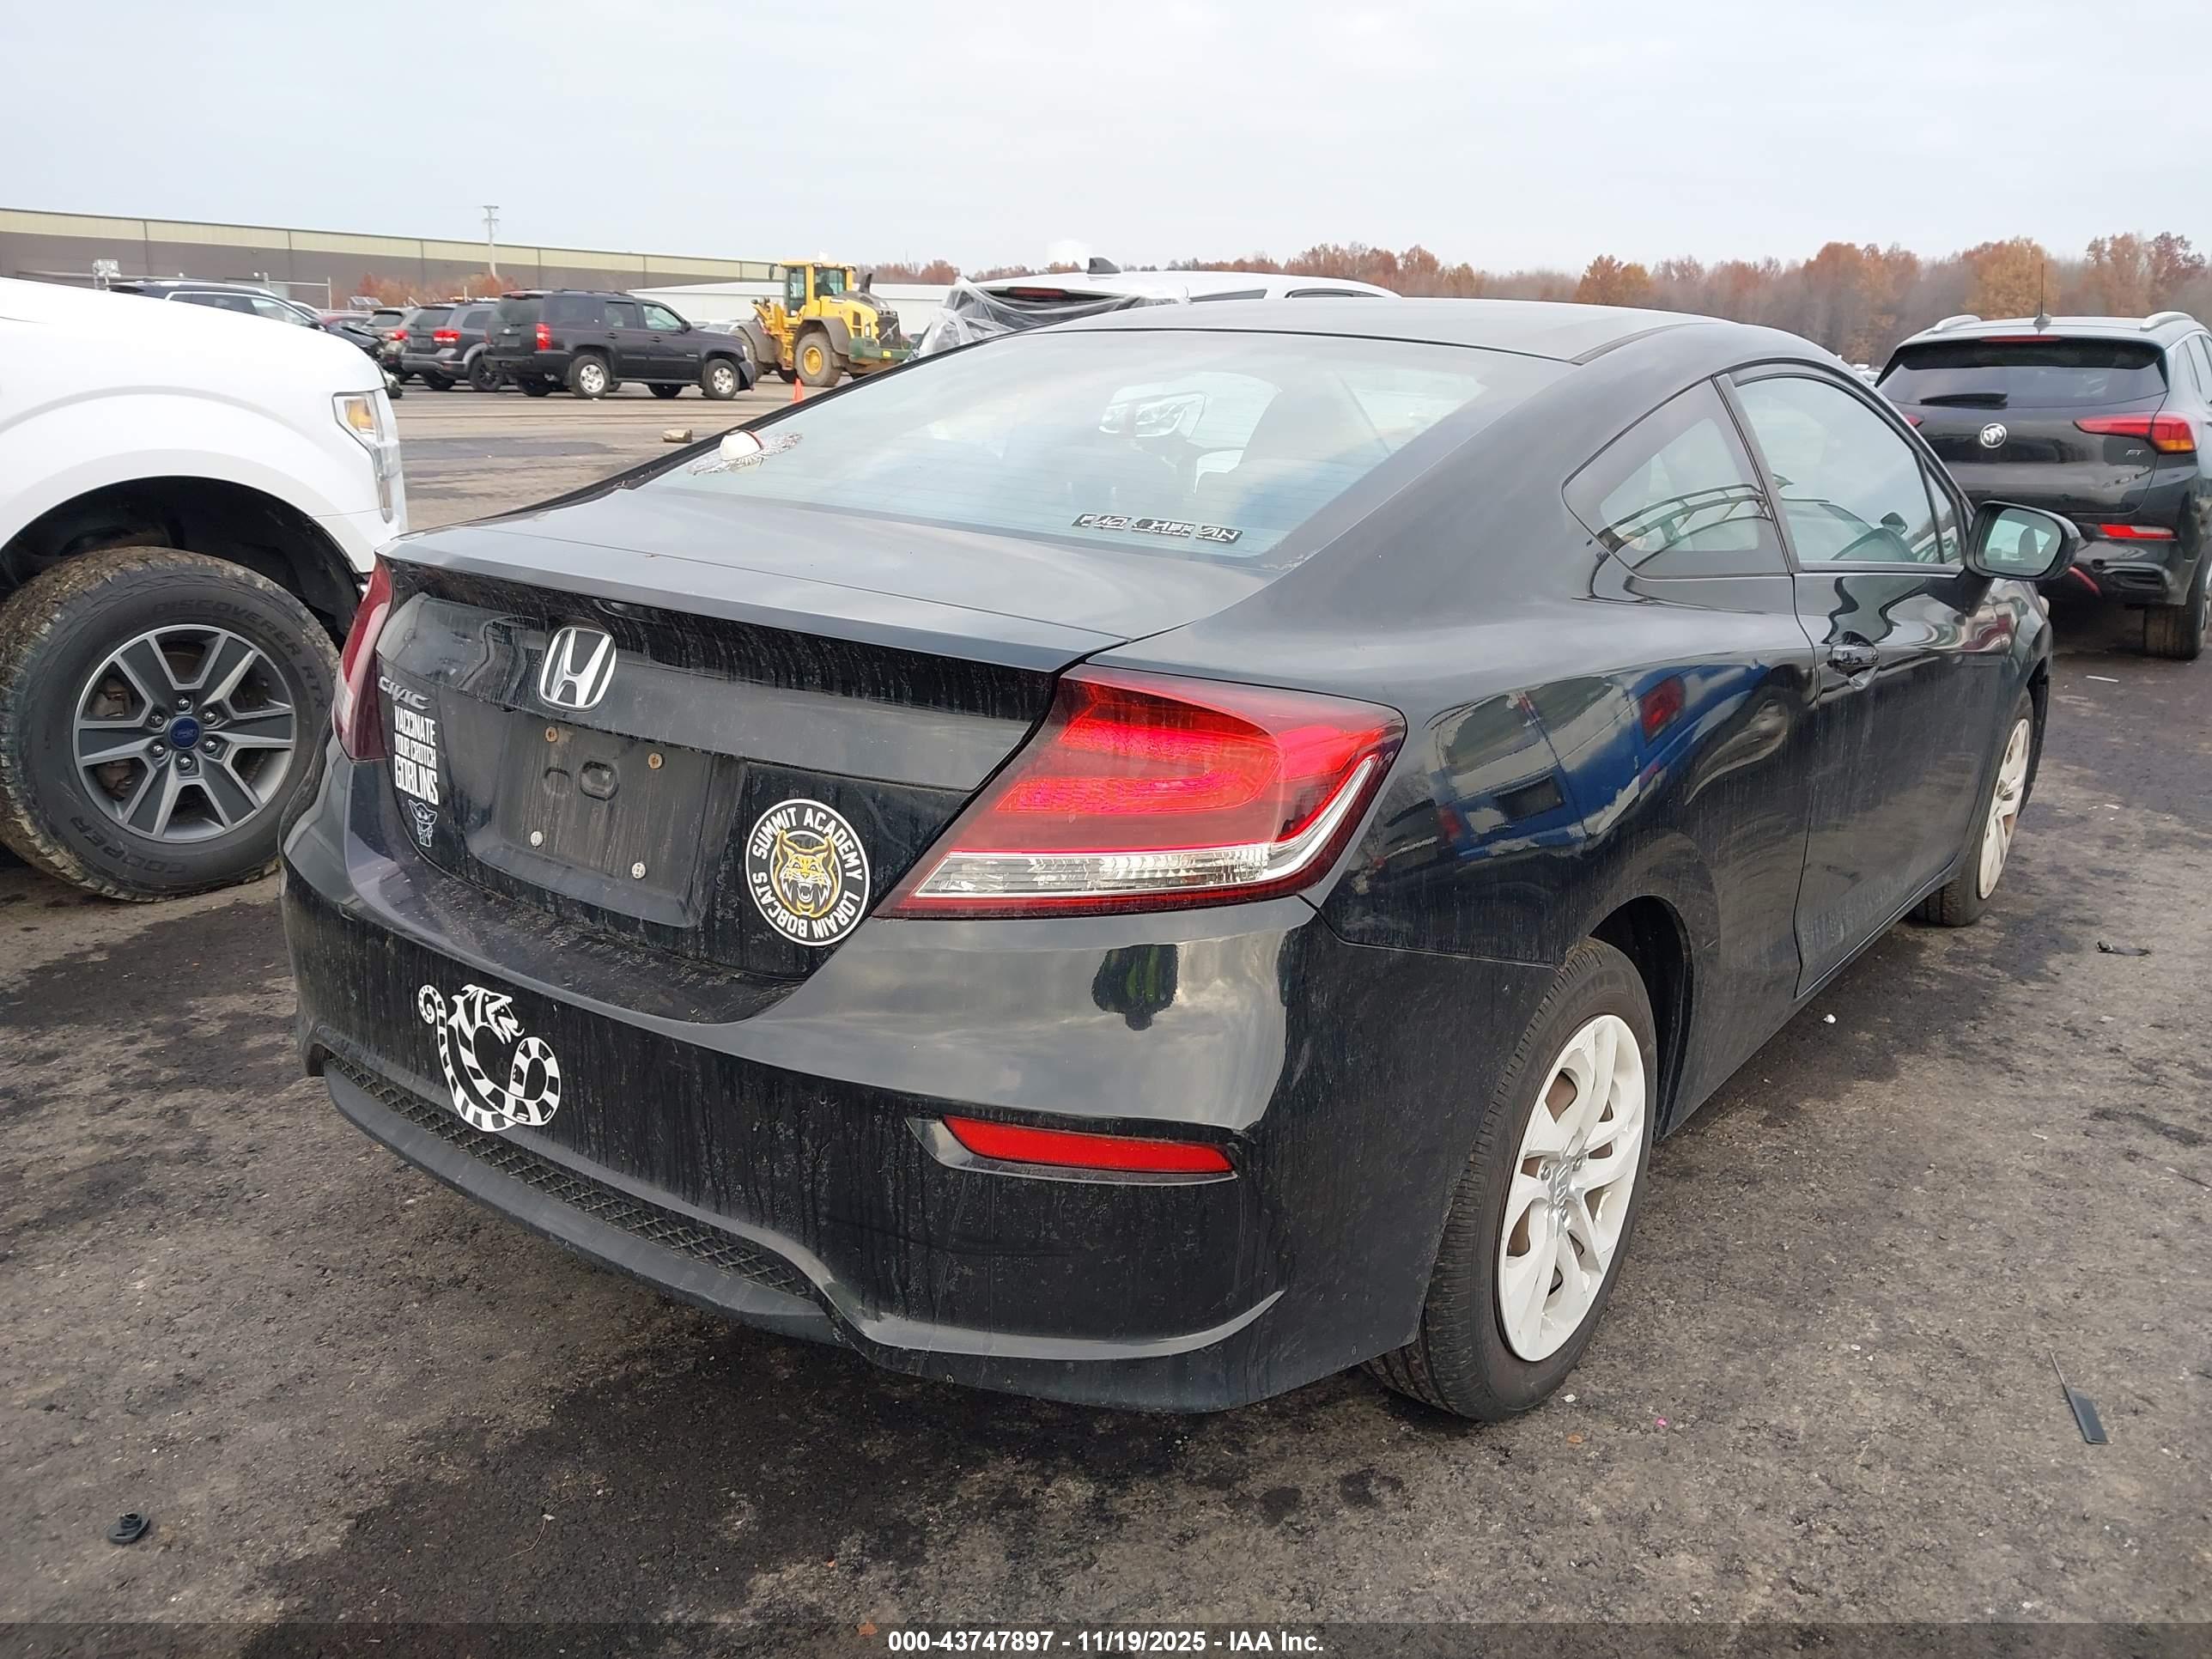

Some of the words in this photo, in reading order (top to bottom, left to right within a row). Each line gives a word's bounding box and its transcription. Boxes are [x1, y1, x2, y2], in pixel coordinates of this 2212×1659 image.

[153, 599, 302, 657] DISCOVERER
[378, 676, 431, 710] CIVIC
[394, 705, 436, 746] VACCINATE
[394, 732, 410, 757] YOUR
[410, 740, 436, 769] CROTCH
[394, 754, 439, 805] GOBLINS
[68, 815, 188, 874] COOPER
[752, 807, 797, 860] SUMMIT
[803, 808, 863, 881] ACADEMY
[752, 872, 808, 939] BOBCATS
[811, 890, 860, 939] LORAIN
